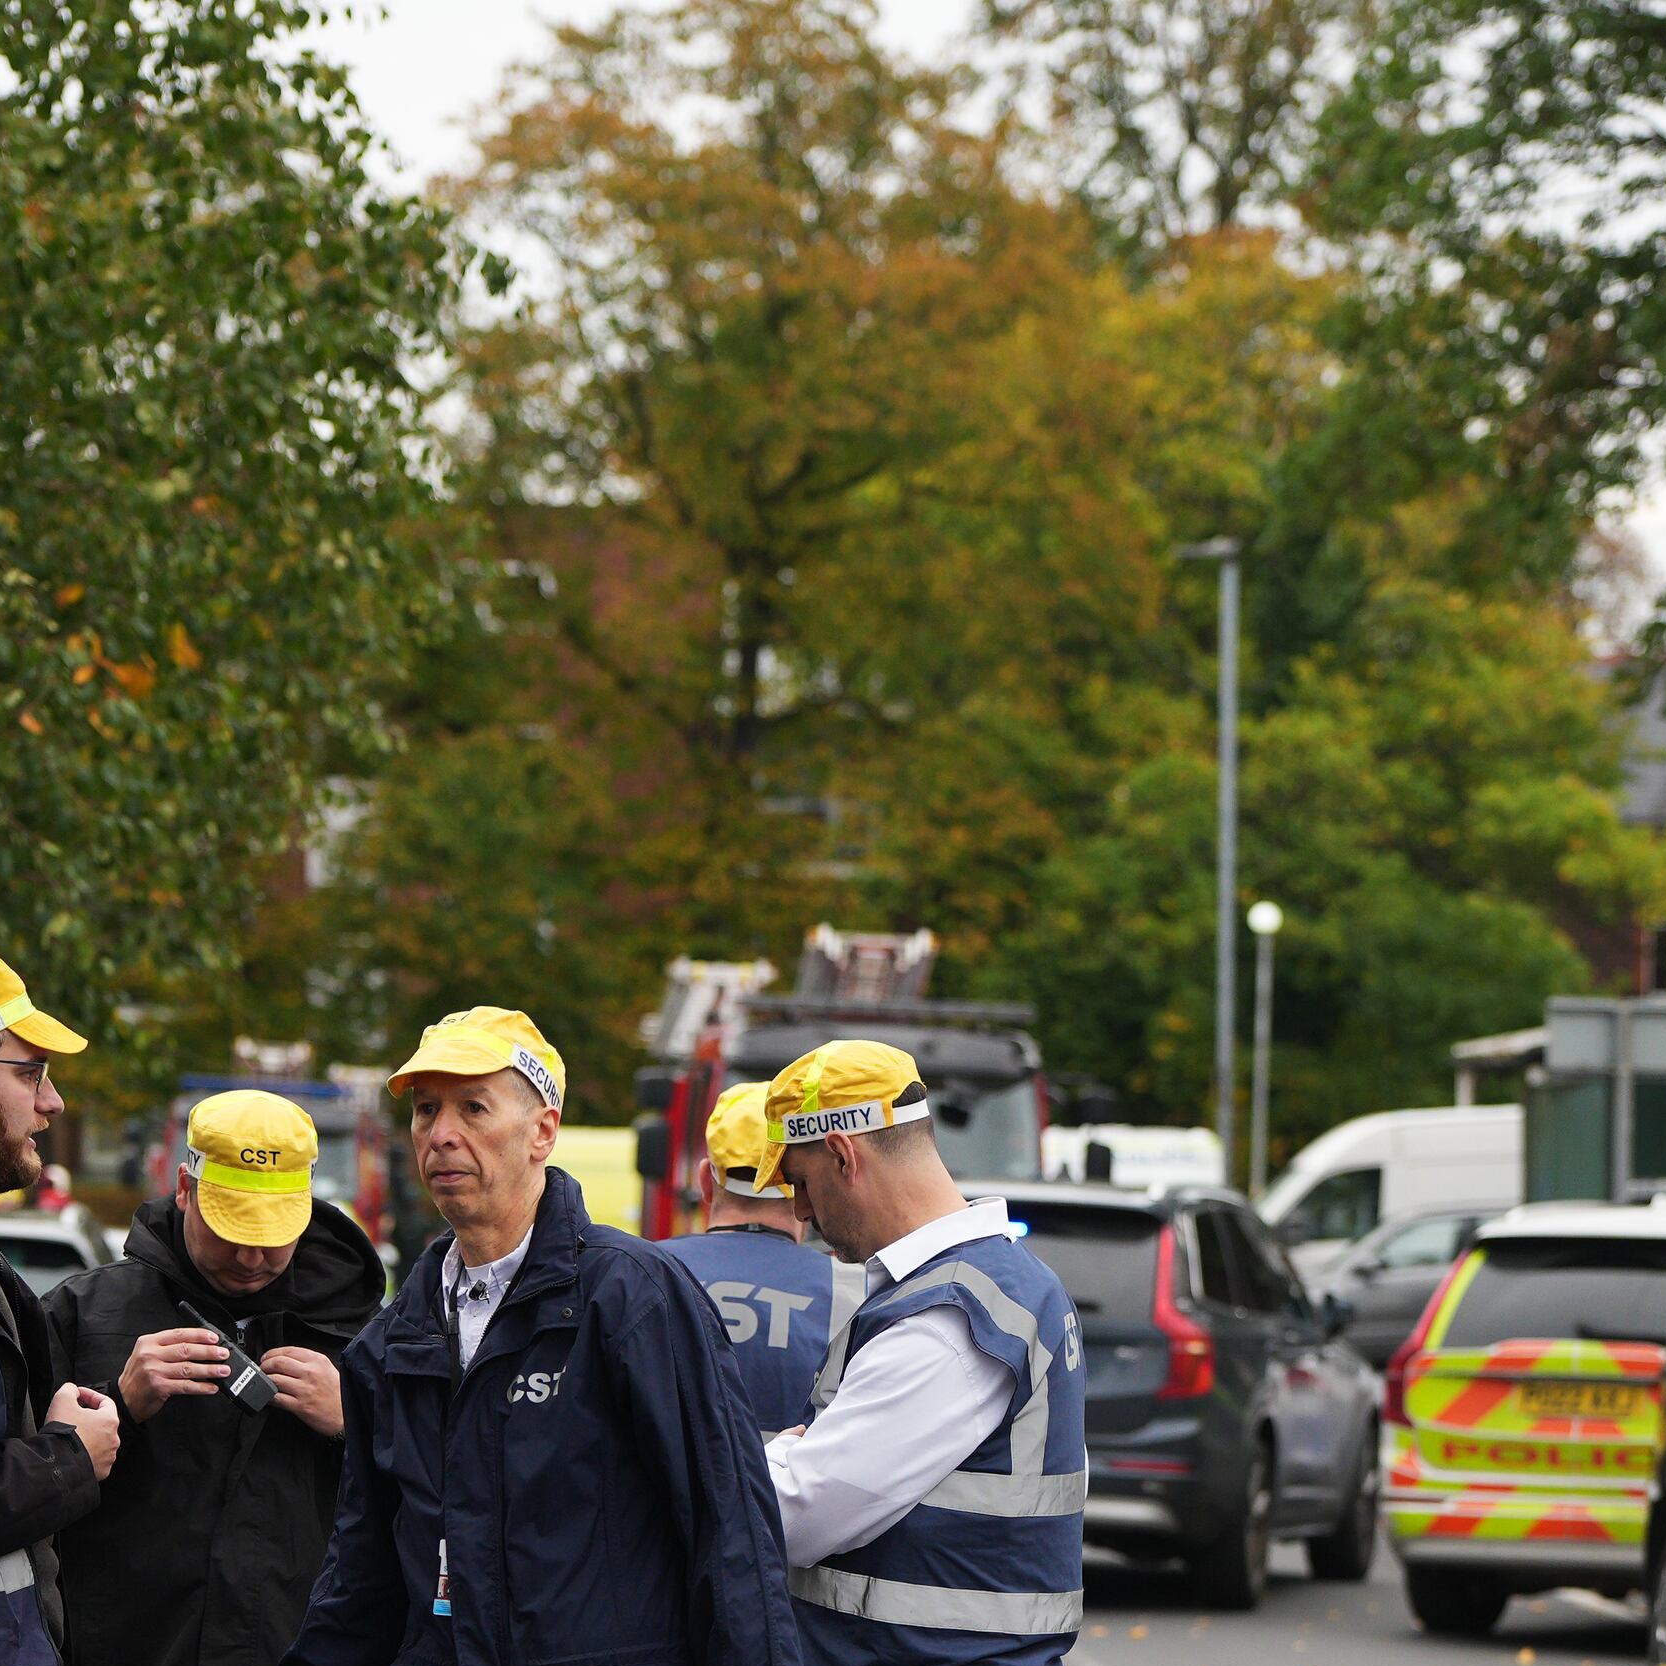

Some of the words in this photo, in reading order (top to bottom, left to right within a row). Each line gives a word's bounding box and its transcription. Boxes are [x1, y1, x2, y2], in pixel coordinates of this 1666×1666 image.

[788, 1107, 870, 1137] SECURITY
[240, 1148, 281, 1165] CST
[701, 1280, 814, 1349] ST
[1441, 1439, 1655, 1474] POLIC
